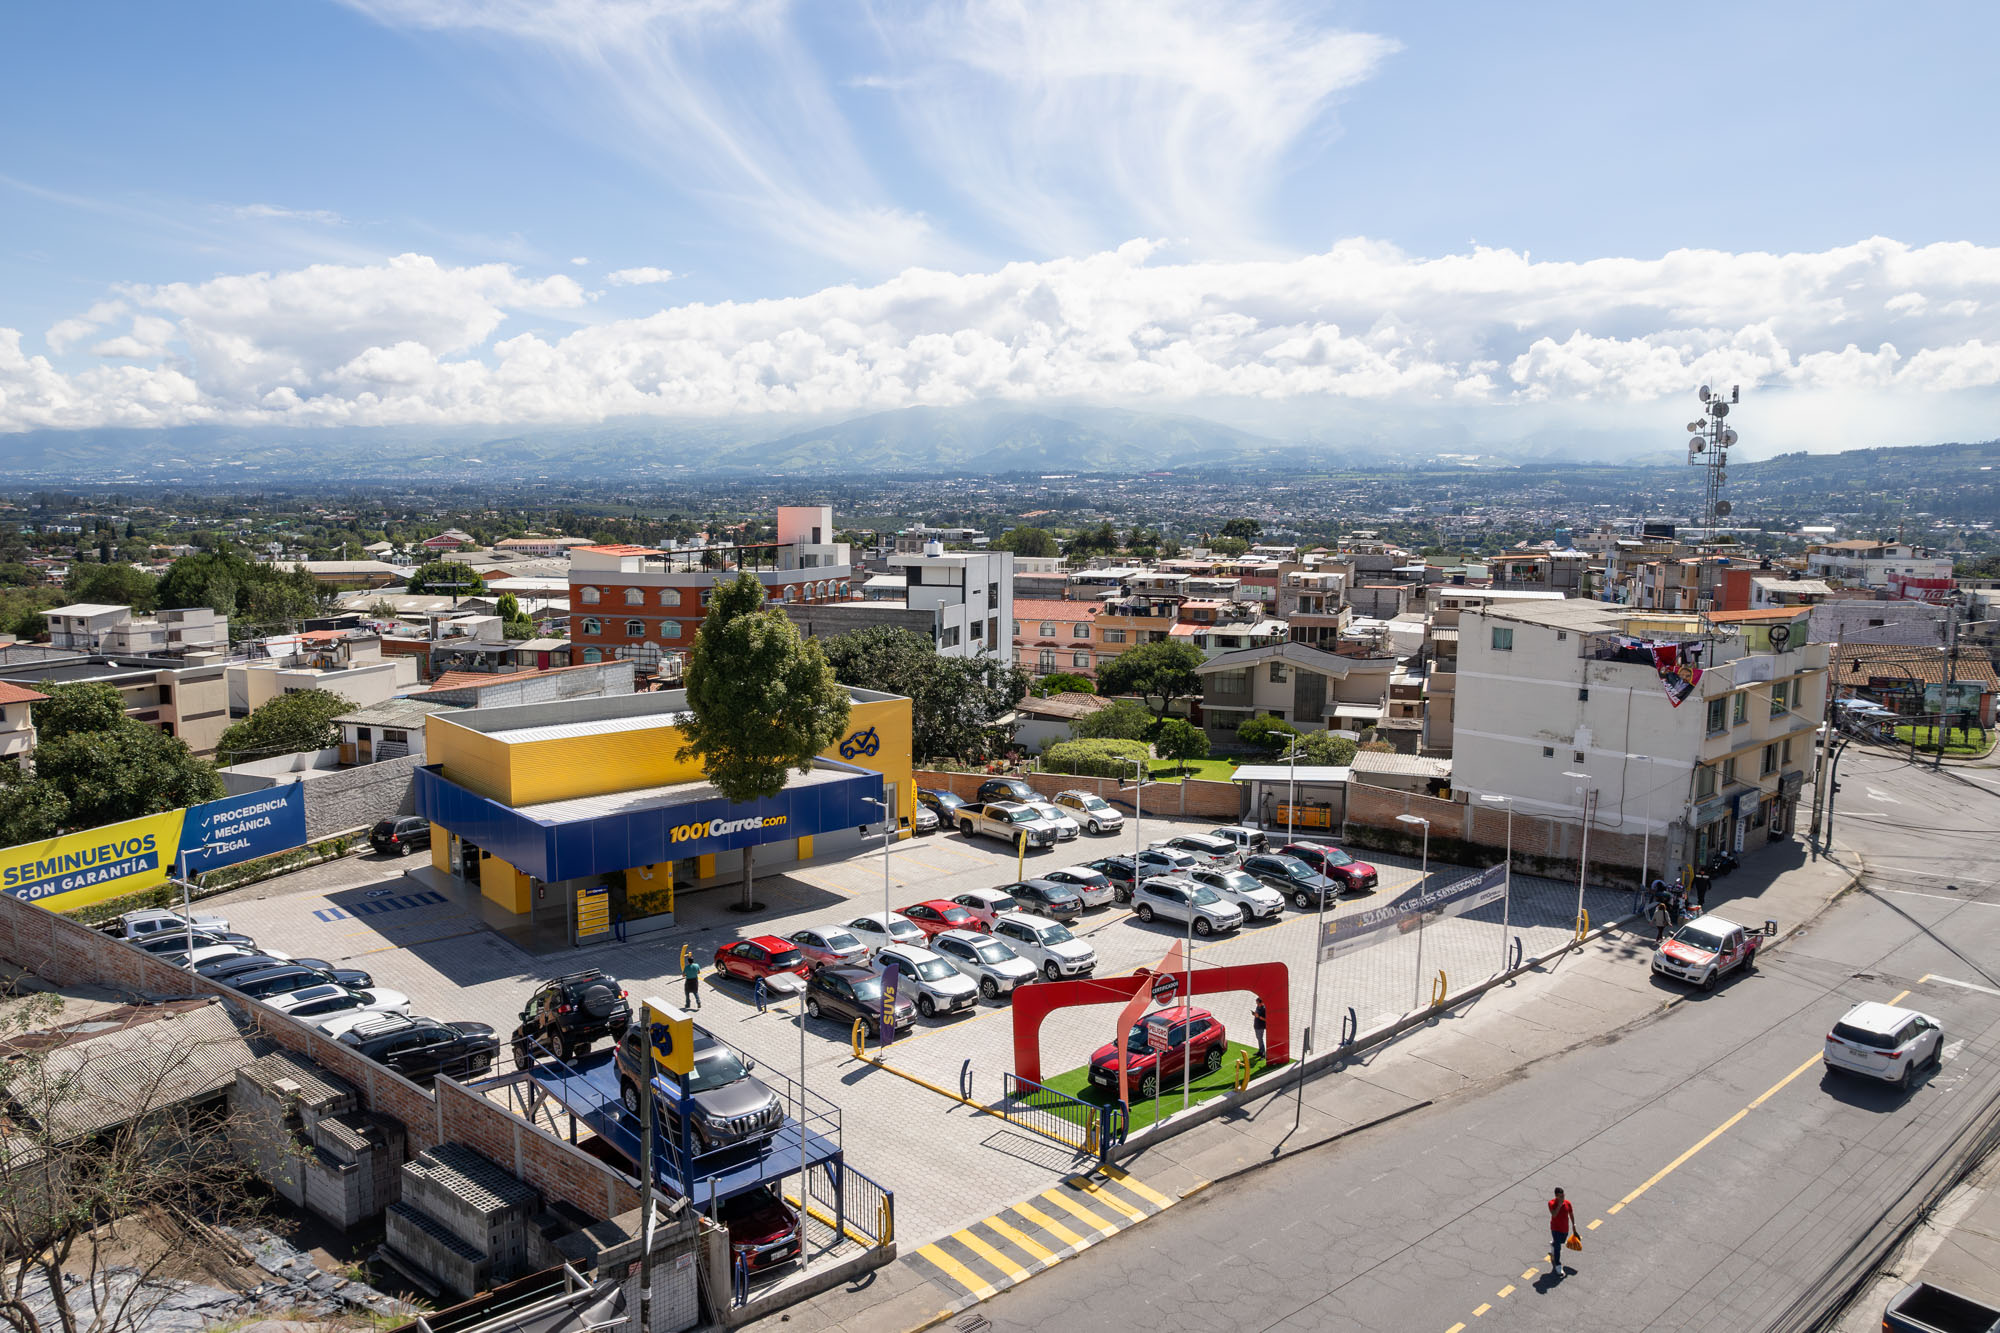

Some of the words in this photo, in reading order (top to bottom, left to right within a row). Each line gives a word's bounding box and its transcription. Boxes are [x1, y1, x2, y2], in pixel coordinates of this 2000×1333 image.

[213, 797, 288, 825] PROCEDENCIA
[214, 816, 272, 840] MECÁNICA
[669, 815, 788, 843] 1001Carros.com
[3, 833, 157, 886] SEMINUEVOS
[216, 838, 251, 855] LEGAL
[16, 881, 56, 901] CON
[61, 857, 149, 891] GARANTÍA
[883, 986, 895, 1026] SUVs
[1149, 1023, 1168, 1037] PELIGRO
